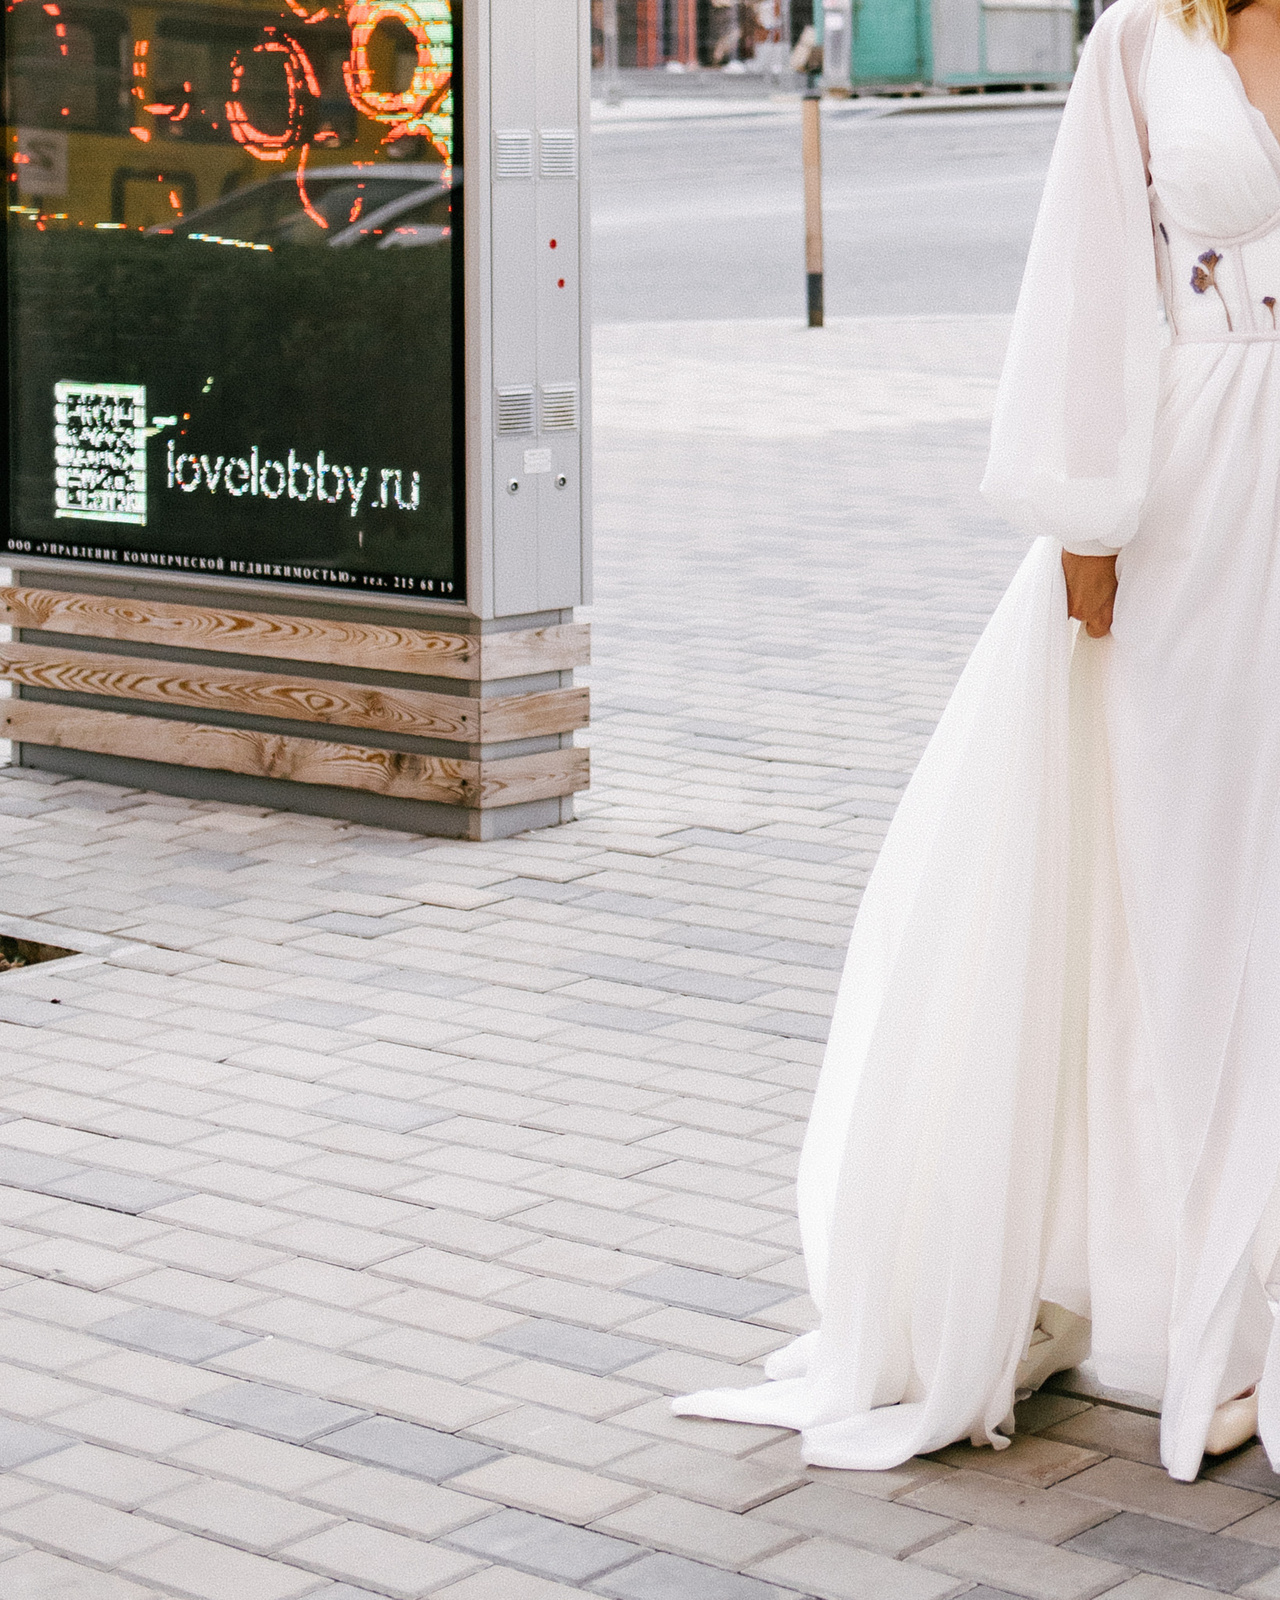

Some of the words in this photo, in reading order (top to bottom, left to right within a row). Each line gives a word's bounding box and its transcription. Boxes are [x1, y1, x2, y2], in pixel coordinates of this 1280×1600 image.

[167, 439, 420, 517] lovelobby.ru
[7, 539, 31, 551] ООО
[123, 550, 224, 570] КОММЕРЧЕСКОЙ
[363, 575, 388, 587] тел.
[394, 576, 414, 589] 215
[420, 579, 434, 591] 68
[441, 581, 454, 593] 19
